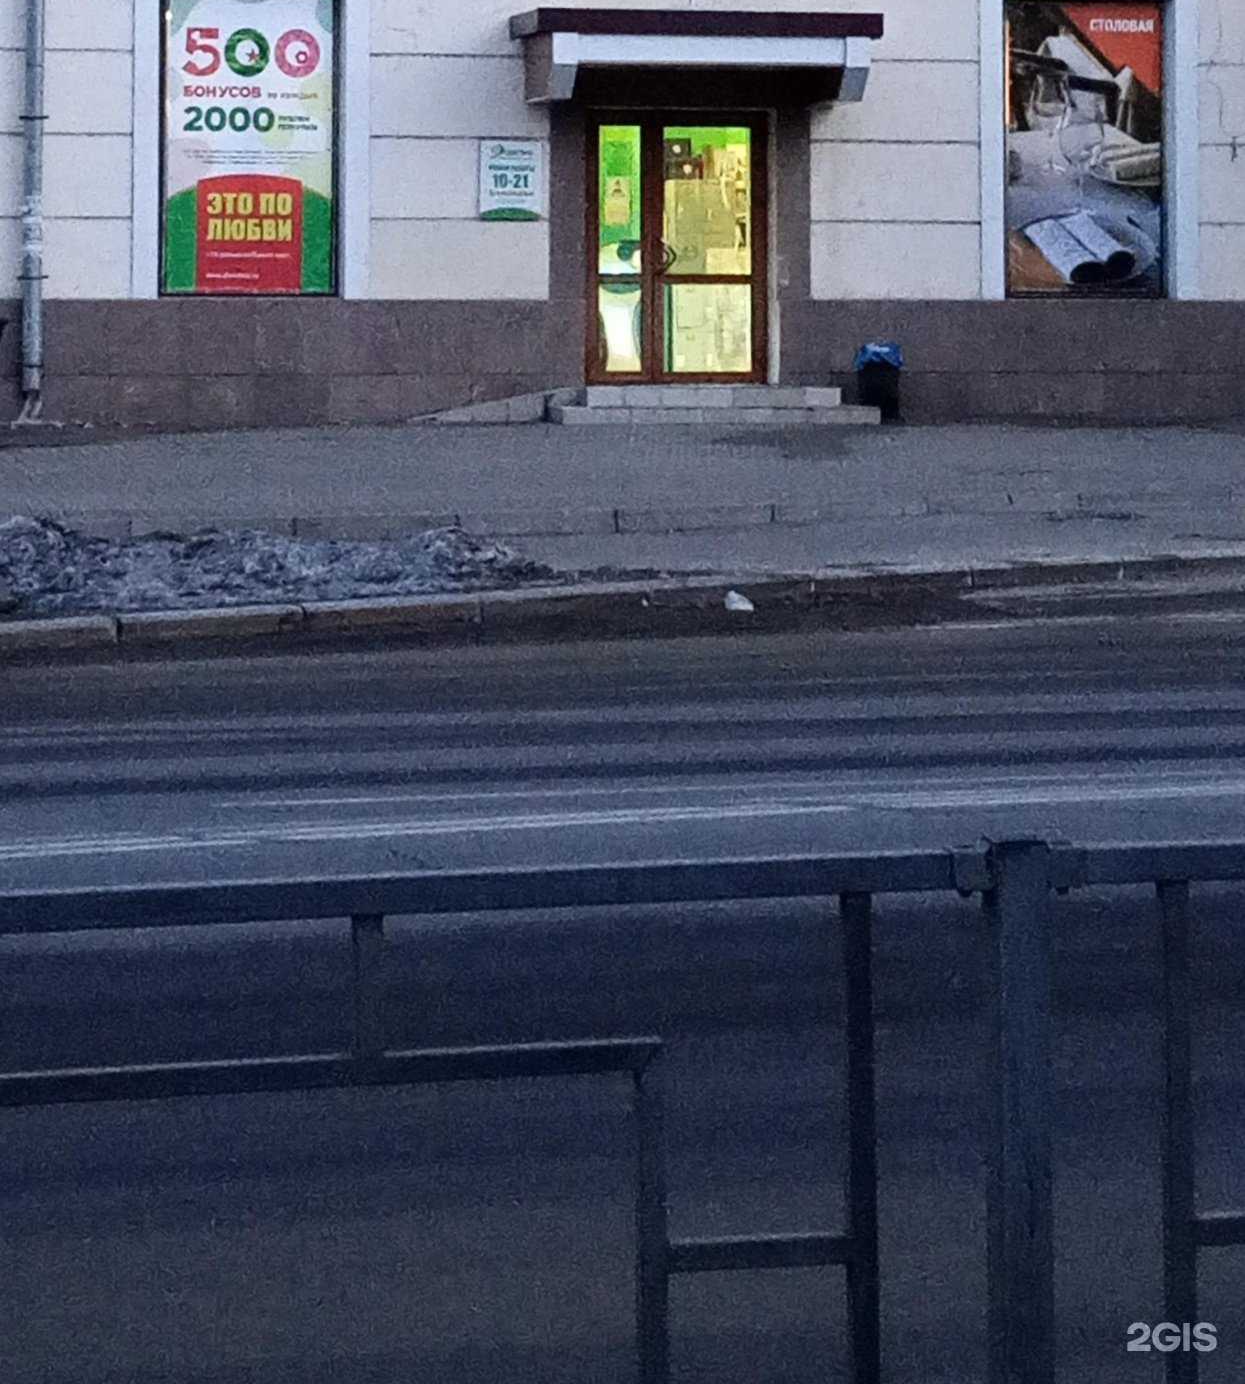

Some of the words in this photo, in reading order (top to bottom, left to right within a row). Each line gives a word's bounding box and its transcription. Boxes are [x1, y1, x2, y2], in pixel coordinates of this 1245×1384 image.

[1089, 18, 1154, 33] СТОЛОВАЯ
[182, 27, 321, 78] 500
[183, 85, 262, 98] БОНУСОВ
[183, 105, 275, 132] 2000
[492, 173, 529, 189] 10-21
[206, 192, 254, 215] ЭТО
[259, 192, 293, 216] ПО
[206, 218, 293, 242] ЛЮБВИ
